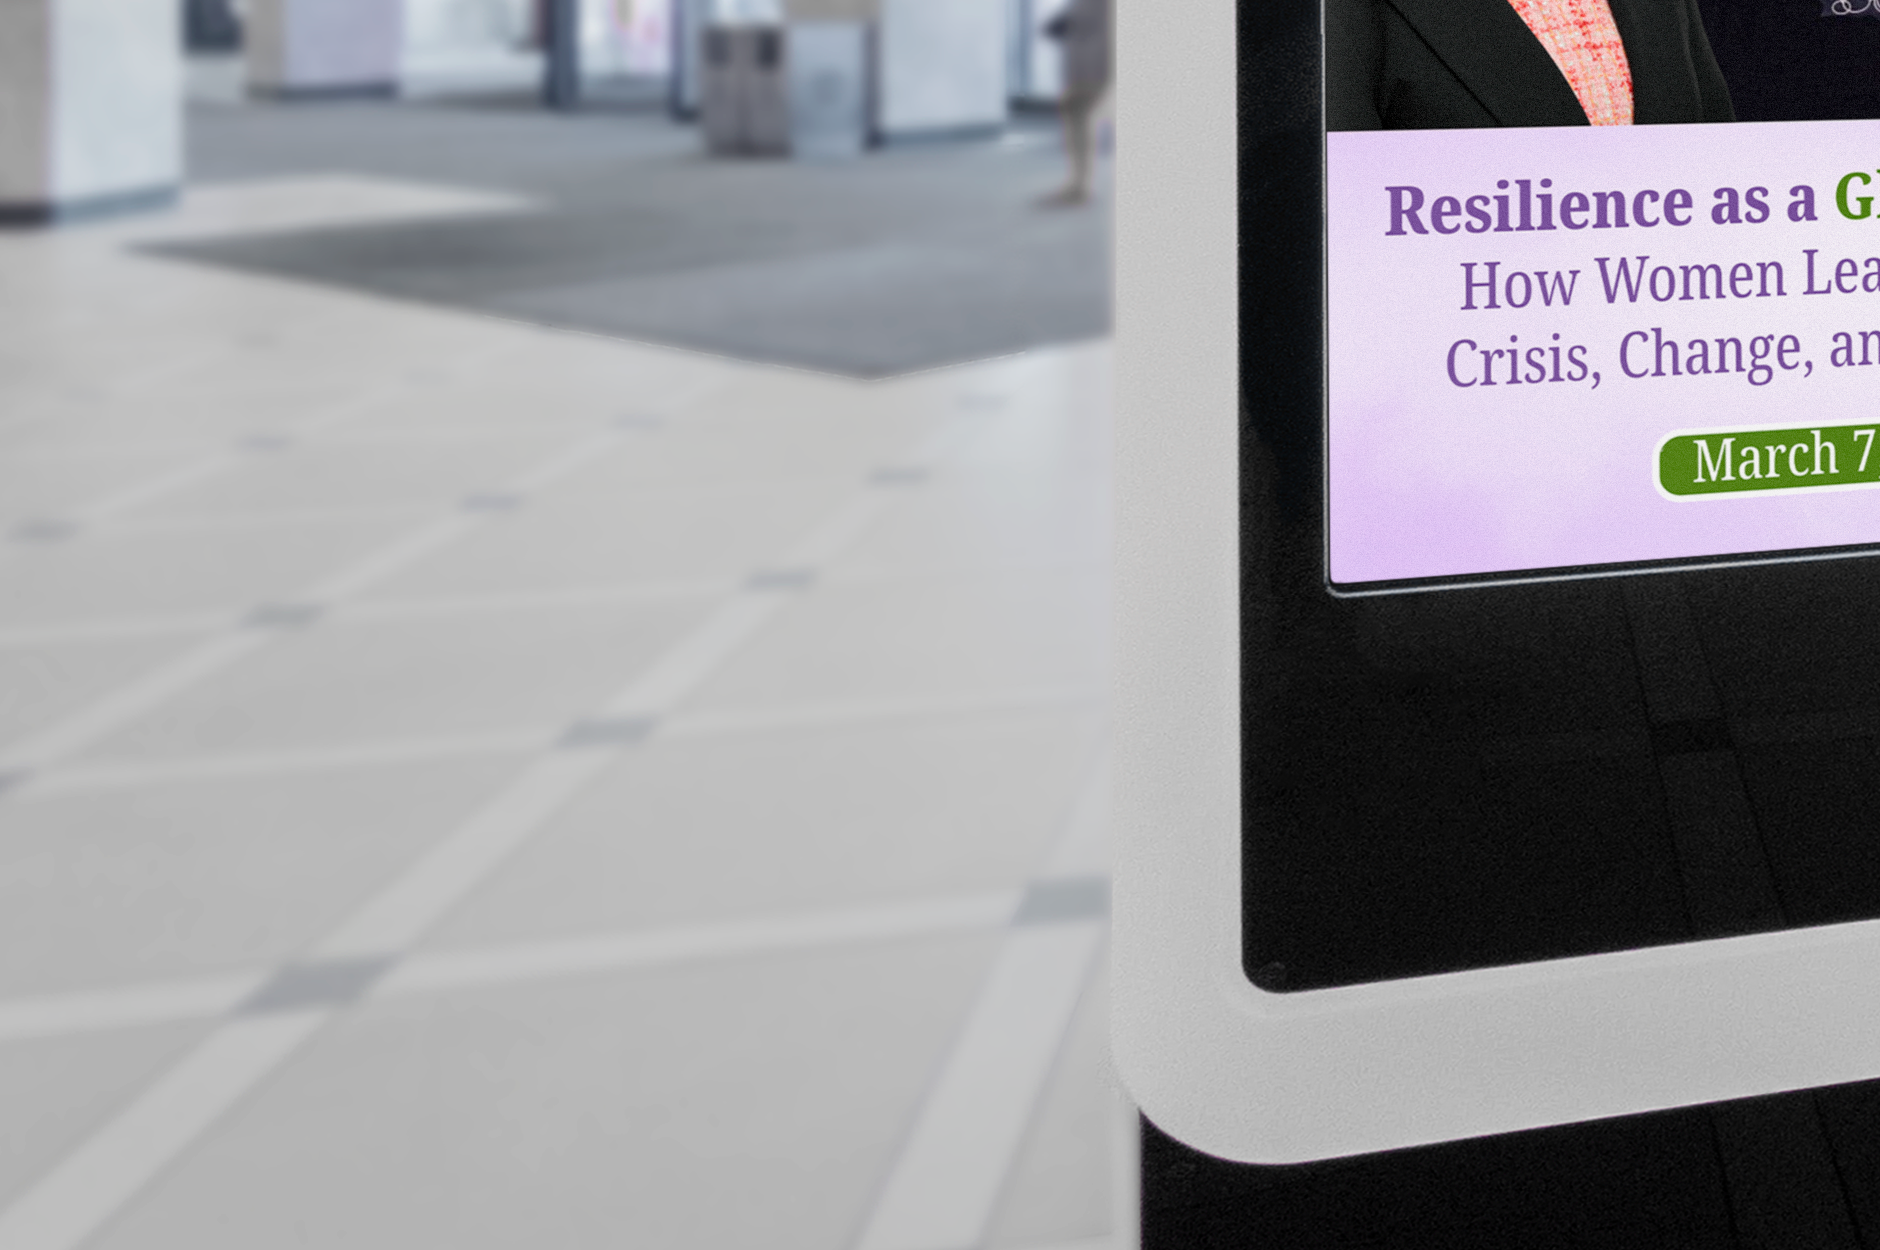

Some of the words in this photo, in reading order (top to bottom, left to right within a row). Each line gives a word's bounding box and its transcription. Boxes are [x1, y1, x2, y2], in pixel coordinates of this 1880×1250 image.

[1385, 178, 1693, 236] Resilience
[1711, 185, 1770, 225] as
[1787, 185, 1818, 222] a
[1460, 261, 1580, 310] How
[1594, 253, 1787, 305] Women
[1446, 334, 1601, 390] Crisis,
[1619, 327, 1813, 386] Change,
[1693, 429, 1839, 483] March
